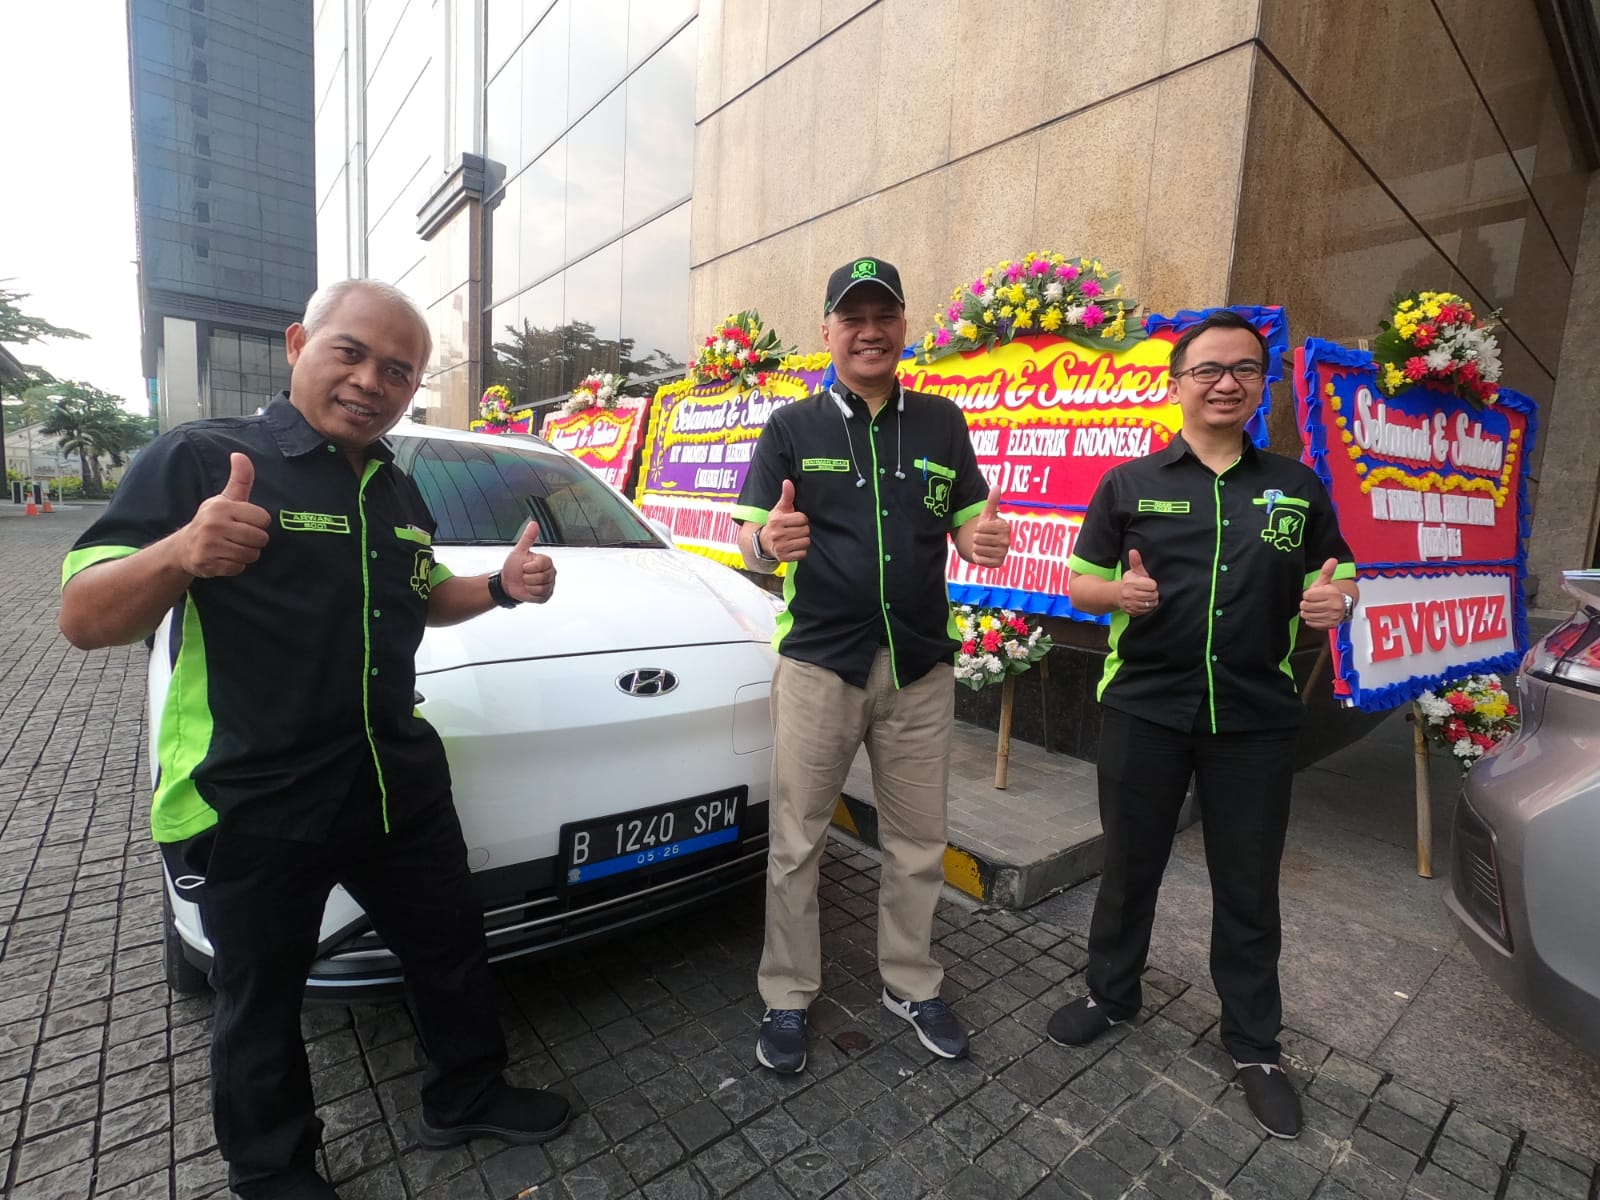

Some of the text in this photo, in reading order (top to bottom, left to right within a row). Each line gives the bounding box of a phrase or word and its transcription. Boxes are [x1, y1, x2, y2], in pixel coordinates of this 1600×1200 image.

[673, 389, 795, 432] Selamat & Suk
[895, 354, 1169, 410] lmat & Sukses
[1006, 428, 1070, 457] ELEKTRIK
[1072, 427, 1152, 458] INDONESIA
[1353, 388, 1432, 462] Selamat
[1433, 412, 1449, 462] &
[1363, 595, 1508, 664] EVCUZZ
[573, 796, 738, 865] B 1240 SPW
